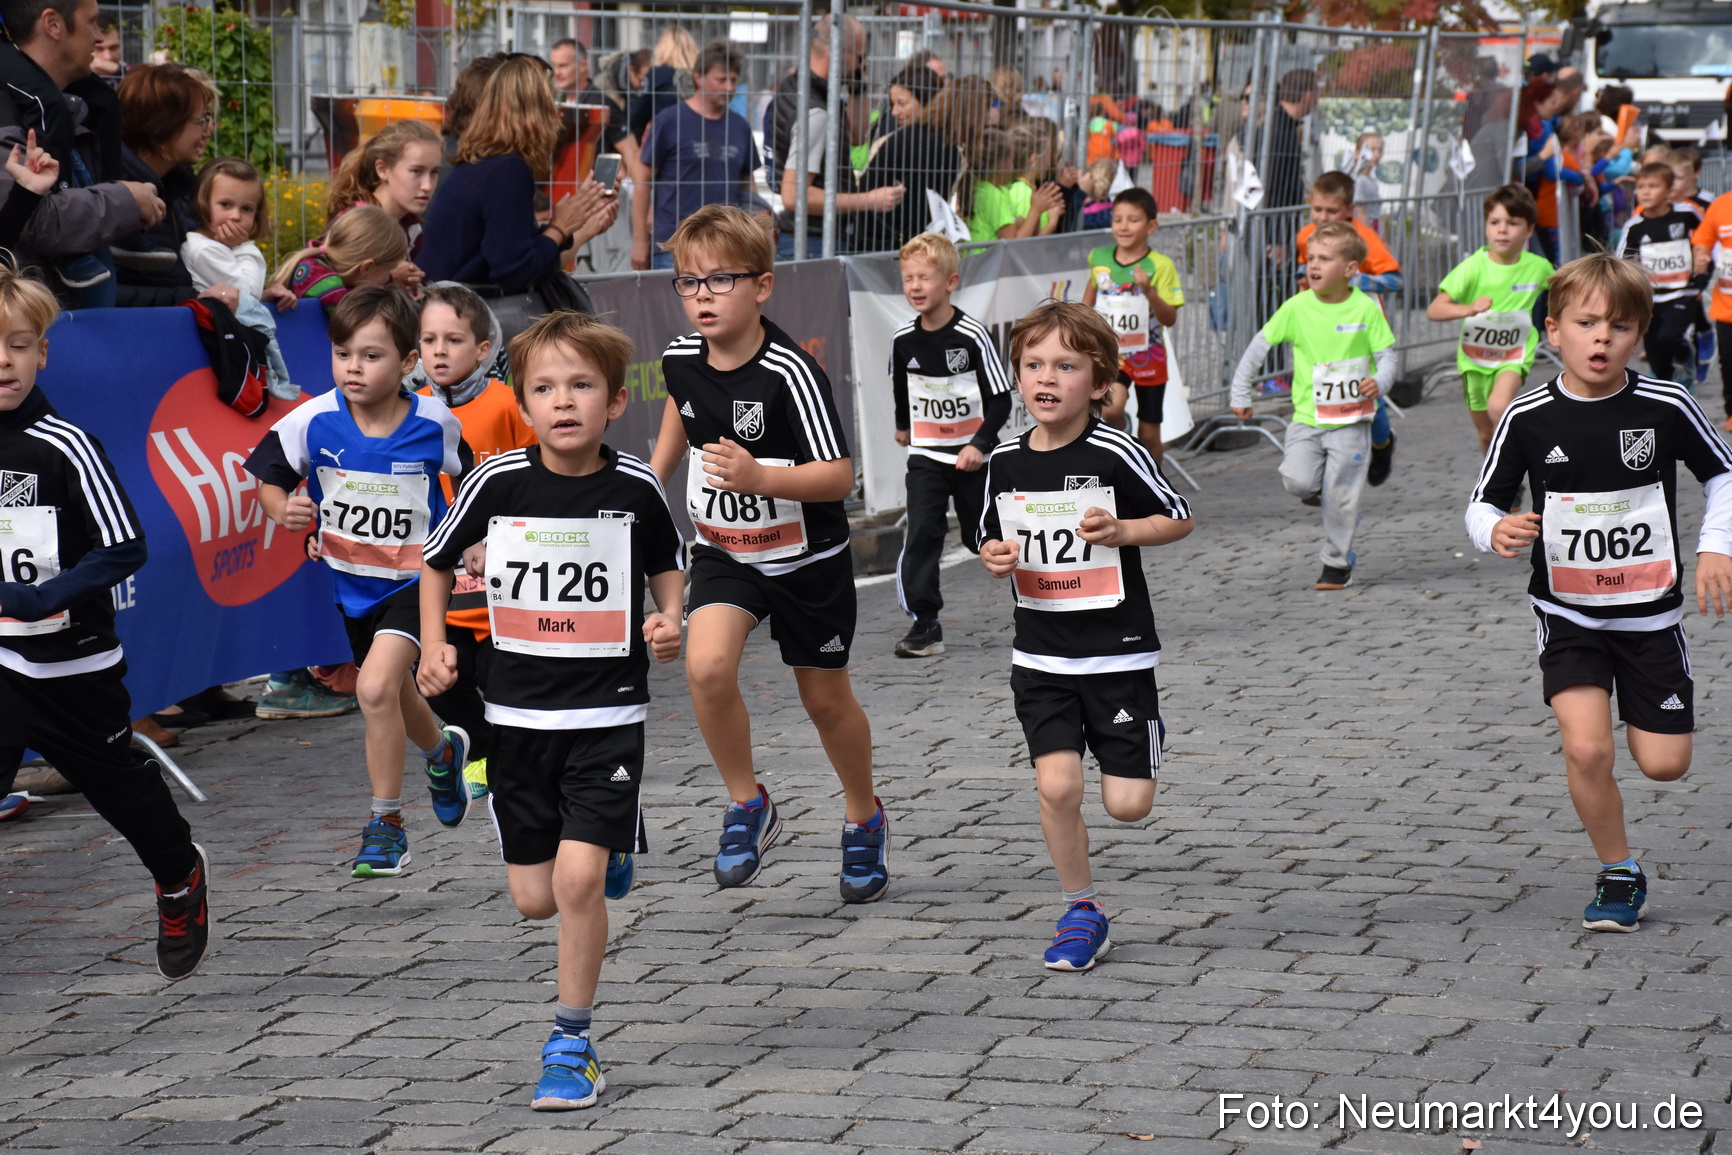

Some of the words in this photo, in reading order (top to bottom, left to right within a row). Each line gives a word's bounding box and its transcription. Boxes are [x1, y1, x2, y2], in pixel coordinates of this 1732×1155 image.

[1650, 256, 1686, 271] 7063
[1105, 314, 1139, 331] 140
[1474, 326, 1520, 346] 7080
[1323, 378, 1366, 400] 710
[919, 397, 970, 419] 7095
[1545, 456, 1569, 464] adidas
[357, 482, 399, 493] BOCK
[702, 487, 778, 523] 7081
[1035, 502, 1077, 513] BOCK
[1588, 500, 1631, 513] BOCK
[333, 500, 413, 540] 7205
[539, 532, 590, 543] BOCK
[711, 530, 782, 546] Marc-Rafael
[1561, 523, 1654, 562] 7062
[211, 539, 258, 582] SPORTS
[506, 561, 609, 602] 7126
[1037, 576, 1082, 591] Samuel
[1596, 573, 1625, 586] Paul
[493, 593, 502, 601] B4
[538, 618, 576, 632] Mark
[820, 644, 845, 652] adidas
[1113, 716, 1134, 724] adidas
